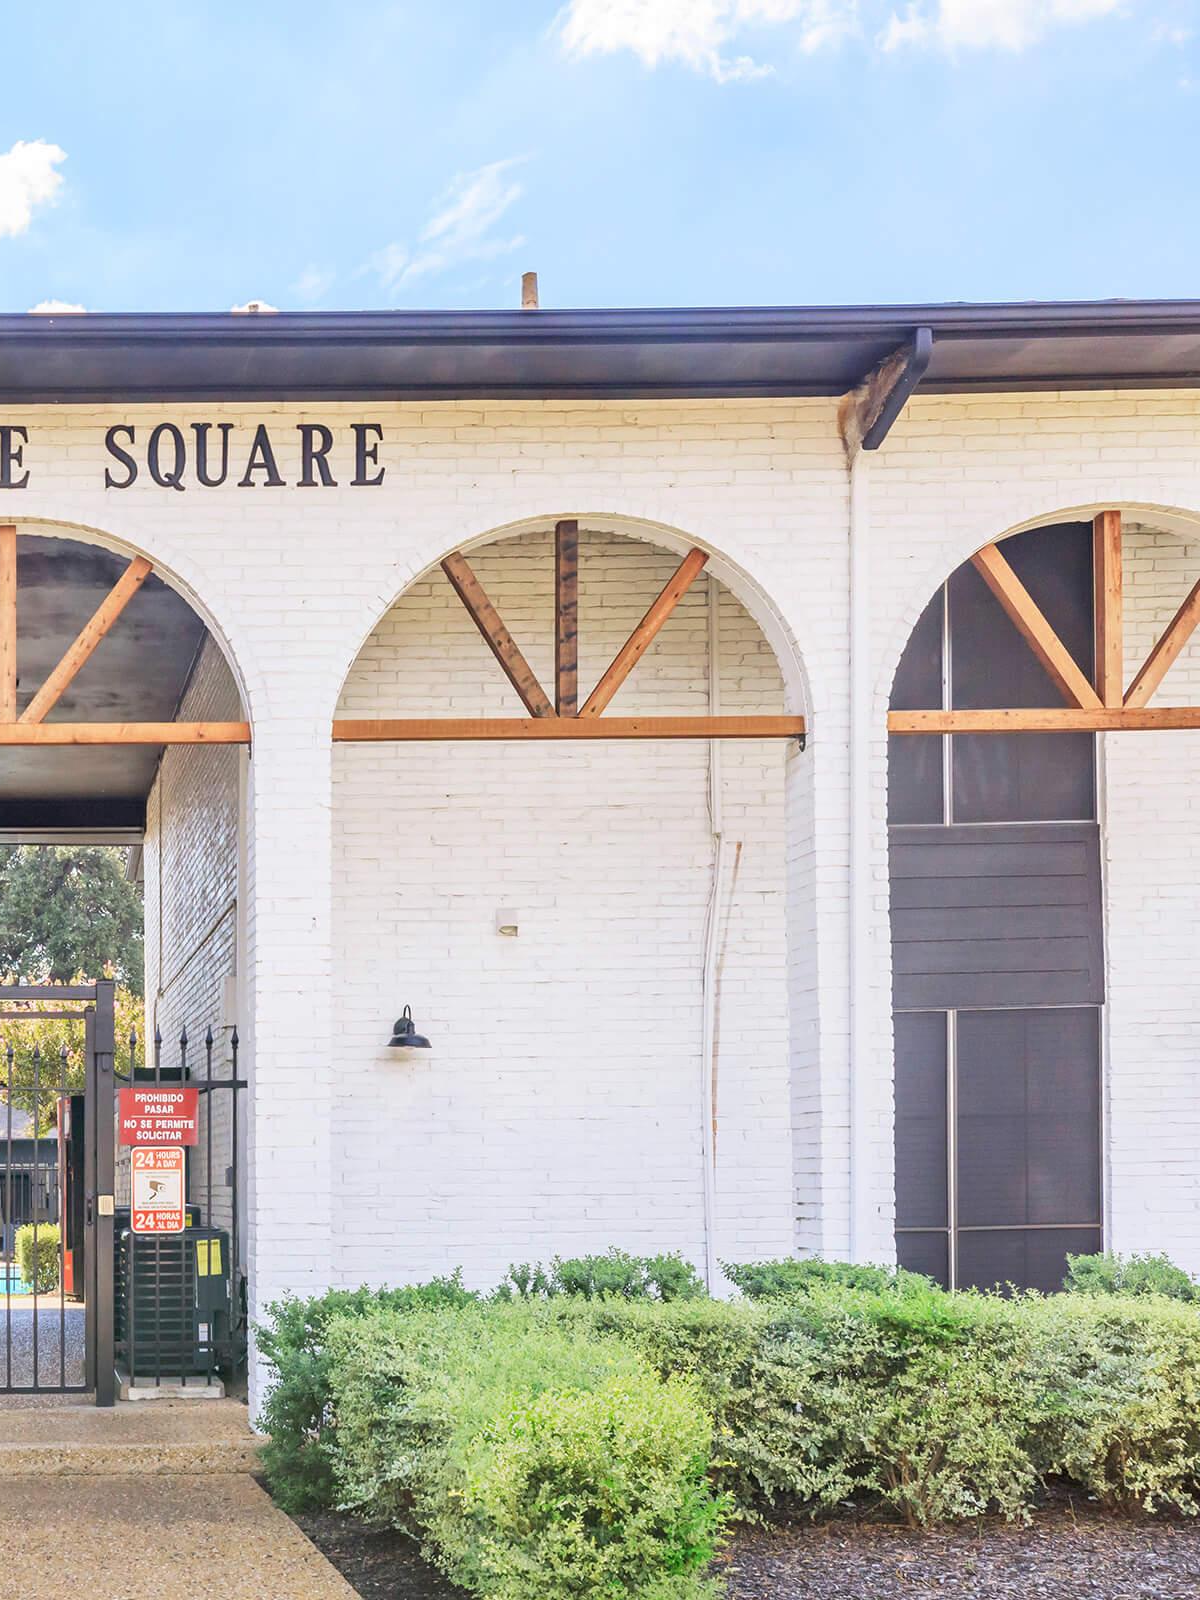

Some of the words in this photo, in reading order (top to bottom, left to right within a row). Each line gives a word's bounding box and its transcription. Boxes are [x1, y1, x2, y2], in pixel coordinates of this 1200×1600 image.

[104, 422, 387, 492] SQUARE
[134, 1093, 184, 1103] PROHIBIDO
[144, 1104, 174, 1114] PASAR
[123, 1119, 137, 1129] NO
[140, 1119, 153, 1129] SE
[155, 1119, 194, 1129] PERMITE
[136, 1130, 182, 1140] SOLICITAR
[135, 1151, 155, 1168] 24
[155, 1151, 181, 1159] HOURS
[156, 1159, 162, 1168] A
[162, 1159, 177, 1168] DAY
[135, 1212, 155, 1229] 24
[155, 1211, 180, 1220] HORAS
